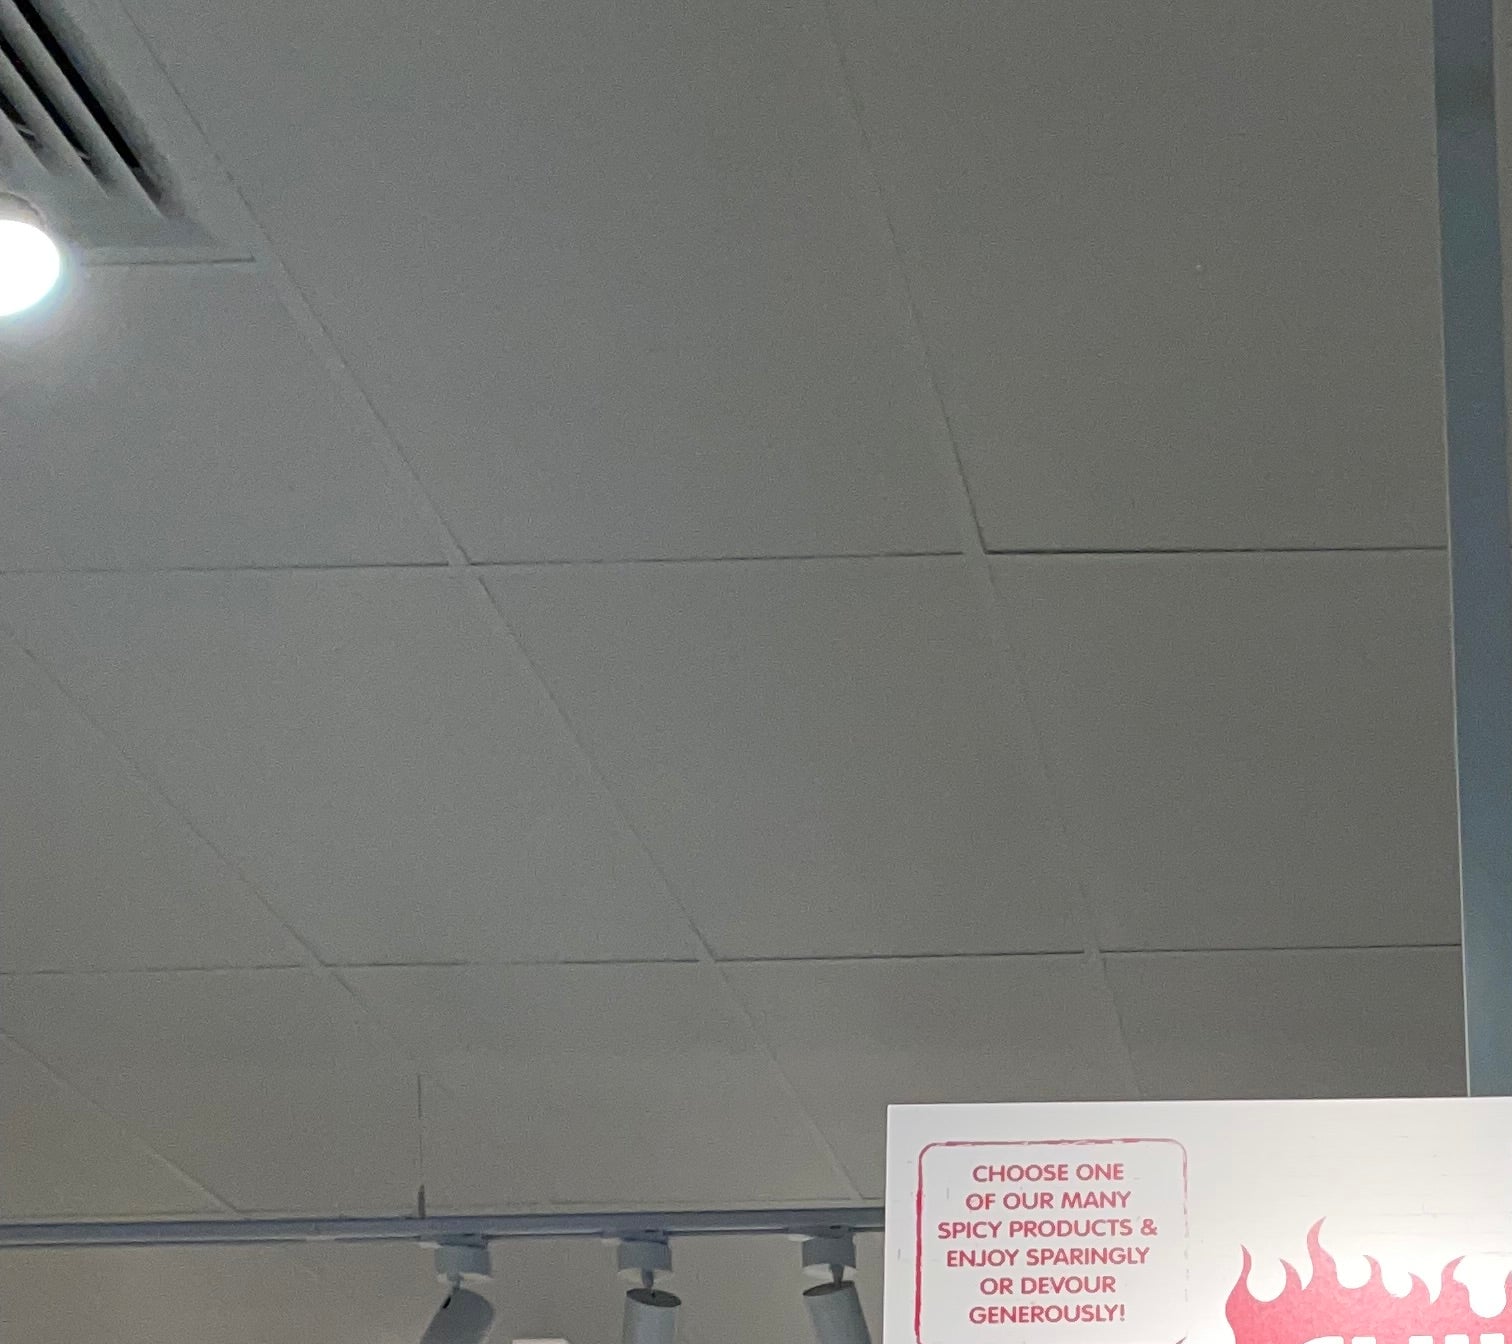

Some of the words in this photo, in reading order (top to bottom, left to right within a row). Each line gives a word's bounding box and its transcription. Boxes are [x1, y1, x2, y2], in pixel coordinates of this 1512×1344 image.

[972, 1164, 1069, 1183] CHOOSE
[1076, 1163, 1124, 1181] ONE
[965, 1193, 996, 1211] OF
[1003, 1192, 1054, 1210] OUR
[1061, 1190, 1131, 1209] MANY
[937, 1221, 1002, 1240] SPICY
[1009, 1218, 1133, 1238] PRODUCTS
[1140, 1218, 1158, 1236] &
[946, 1249, 1019, 1268] ENJOY
[1026, 1246, 1150, 1266] SPARINGLY
[979, 1277, 1013, 1296] OR
[1021, 1275, 1116, 1295] DEVOUR
[968, 1304, 1126, 1324] GENEROUSLY!
